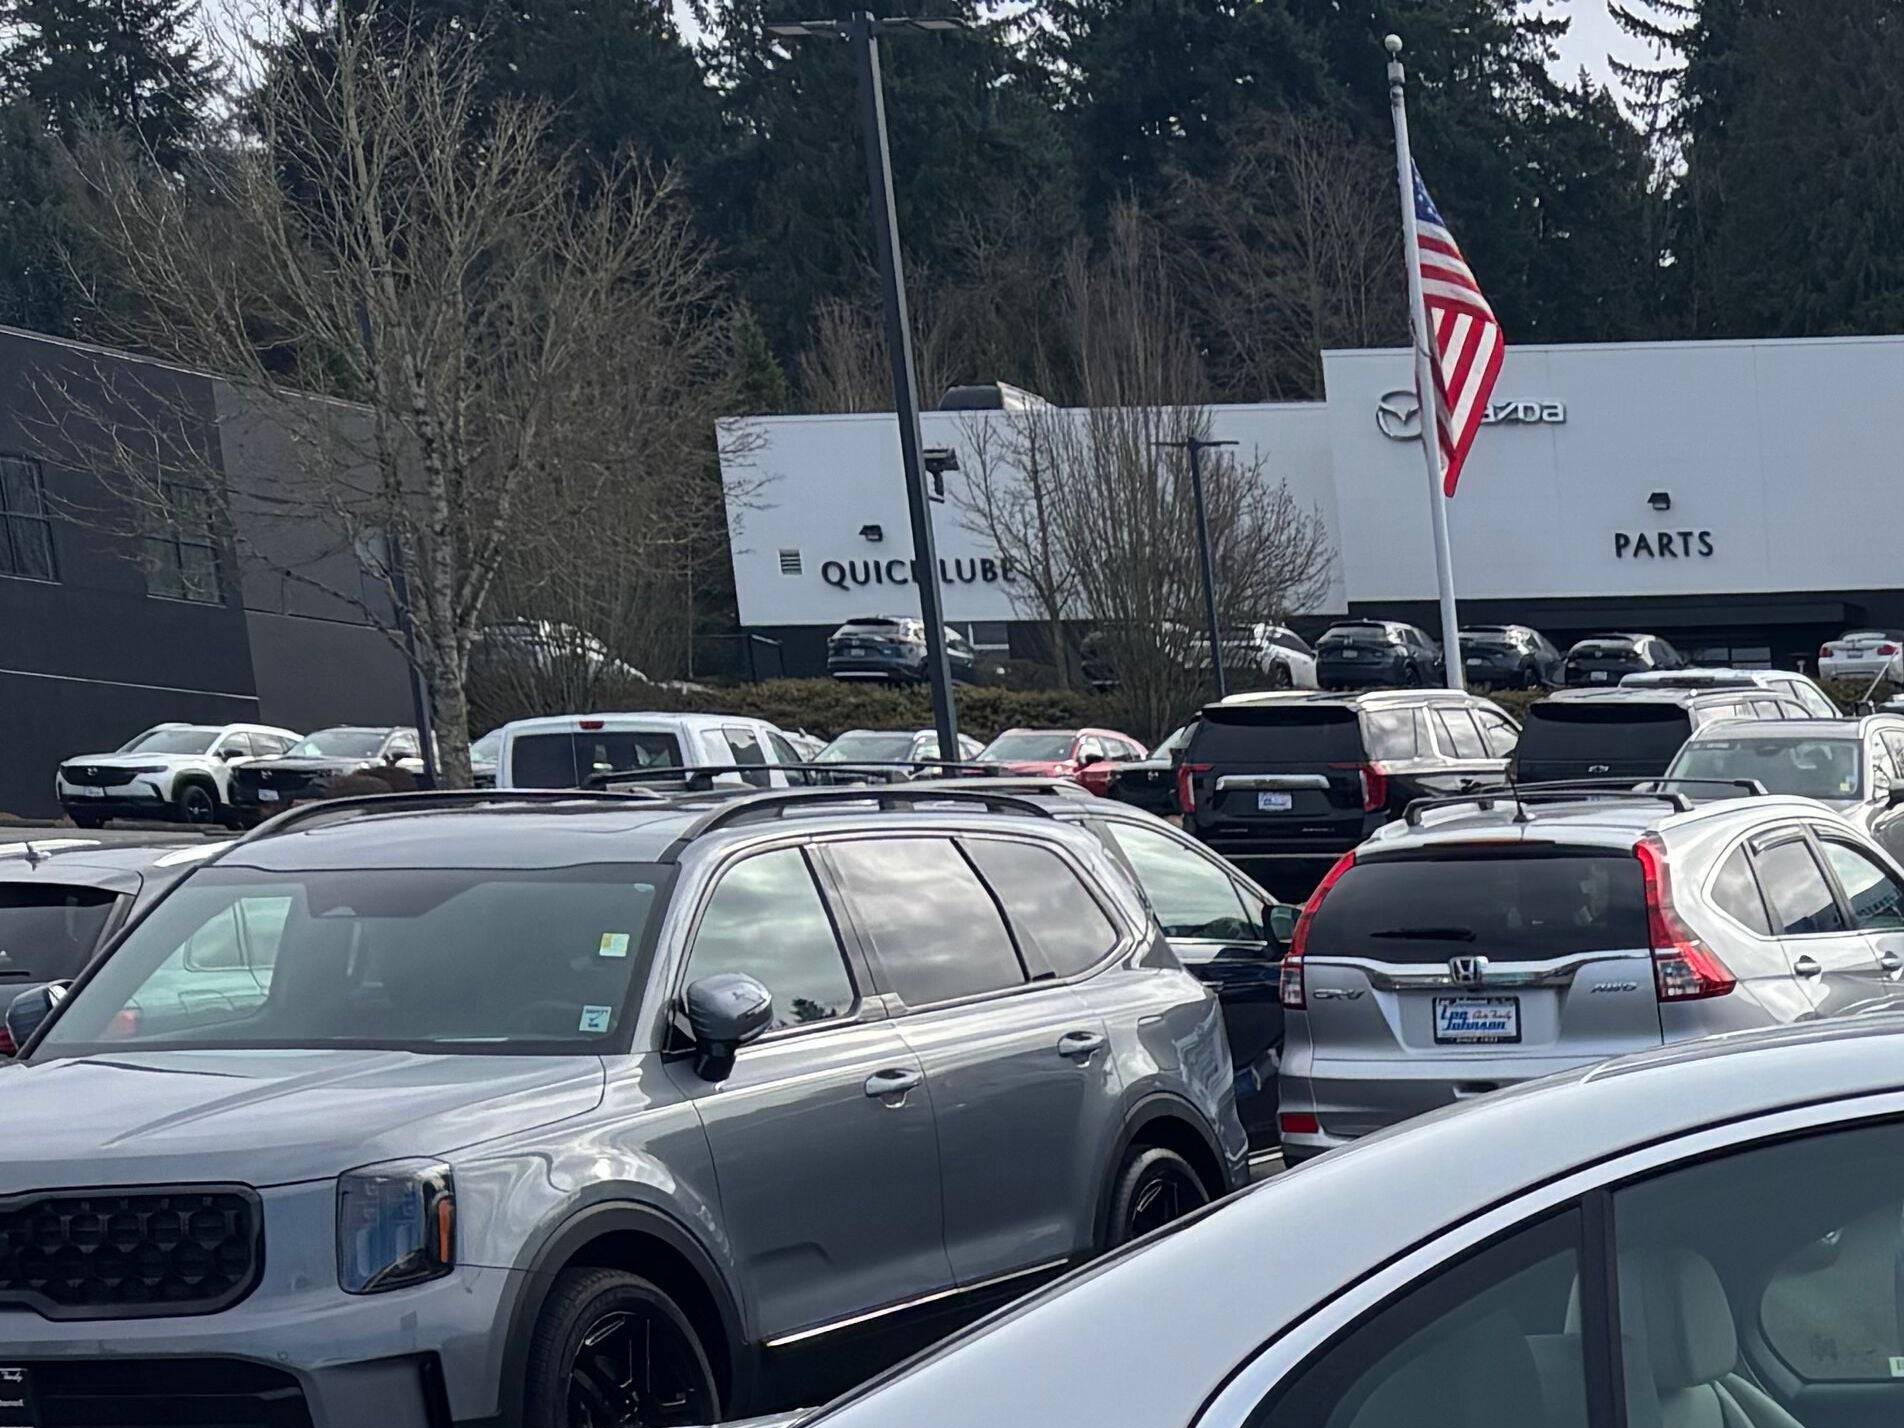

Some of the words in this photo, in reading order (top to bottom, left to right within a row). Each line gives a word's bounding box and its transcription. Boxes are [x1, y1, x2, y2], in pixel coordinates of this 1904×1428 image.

[1480, 400, 1567, 426] azda
[1614, 531, 1714, 558] PARTS
[939, 557, 1018, 584] LUBE
